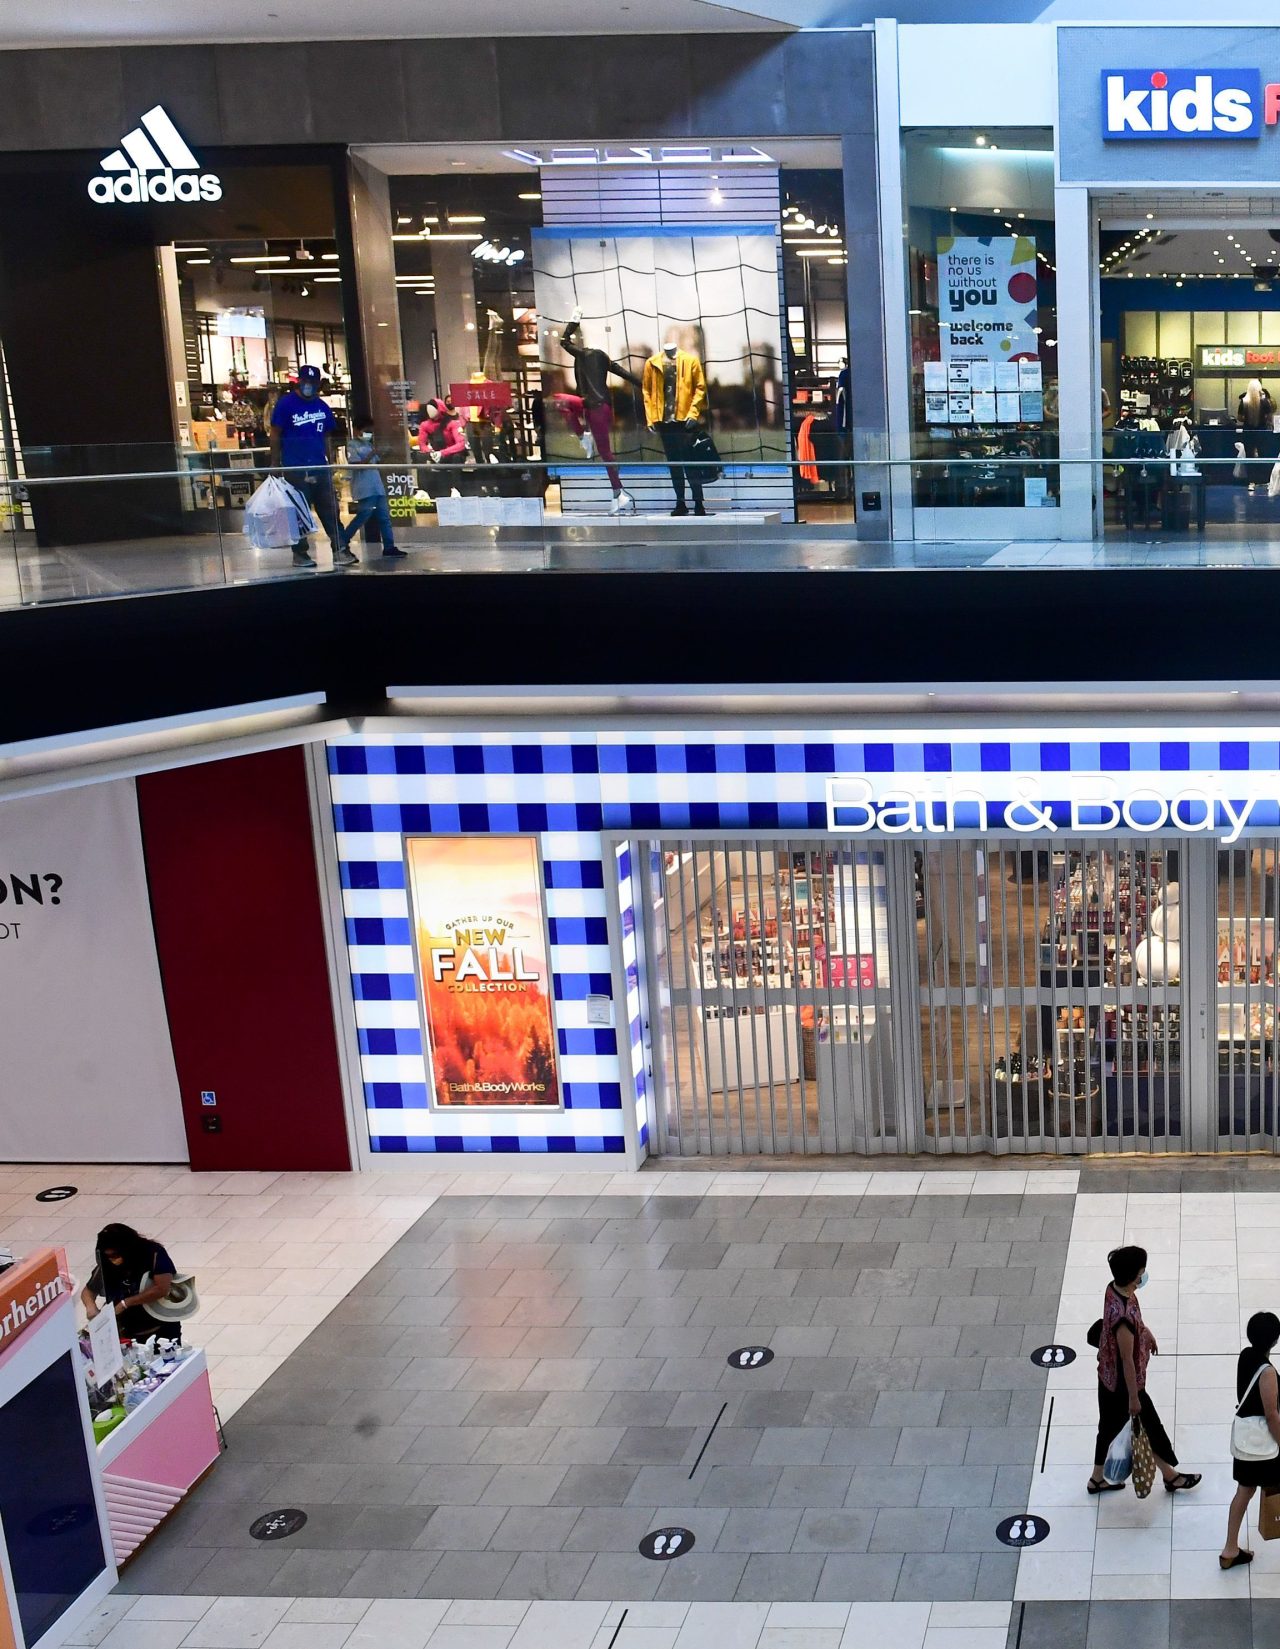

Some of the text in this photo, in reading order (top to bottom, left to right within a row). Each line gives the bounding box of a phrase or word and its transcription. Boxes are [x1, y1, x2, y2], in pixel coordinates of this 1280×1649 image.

[1107, 71, 1254, 132] kids
[87, 166, 223, 204] adidas
[948, 253, 995, 266] there is
[948, 266, 982, 276] no us
[948, 277, 997, 288] without
[949, 289, 998, 312] you
[949, 319, 1014, 332] welcome
[950, 332, 984, 345] back
[1202, 347, 1245, 366] kids
[466, 390, 496, 400] SALE
[386, 472, 416, 486] shop
[389, 509, 417, 518] com
[825, 775, 988, 834] Bath
[1003, 775, 1059, 834] &
[1070, 775, 1261, 844] Body
[445, 915, 515, 931] GATHER UP OUR
[454, 928, 506, 946] NEW
[430, 946, 540, 982] FALL
[447, 982, 527, 994] COLLECTION
